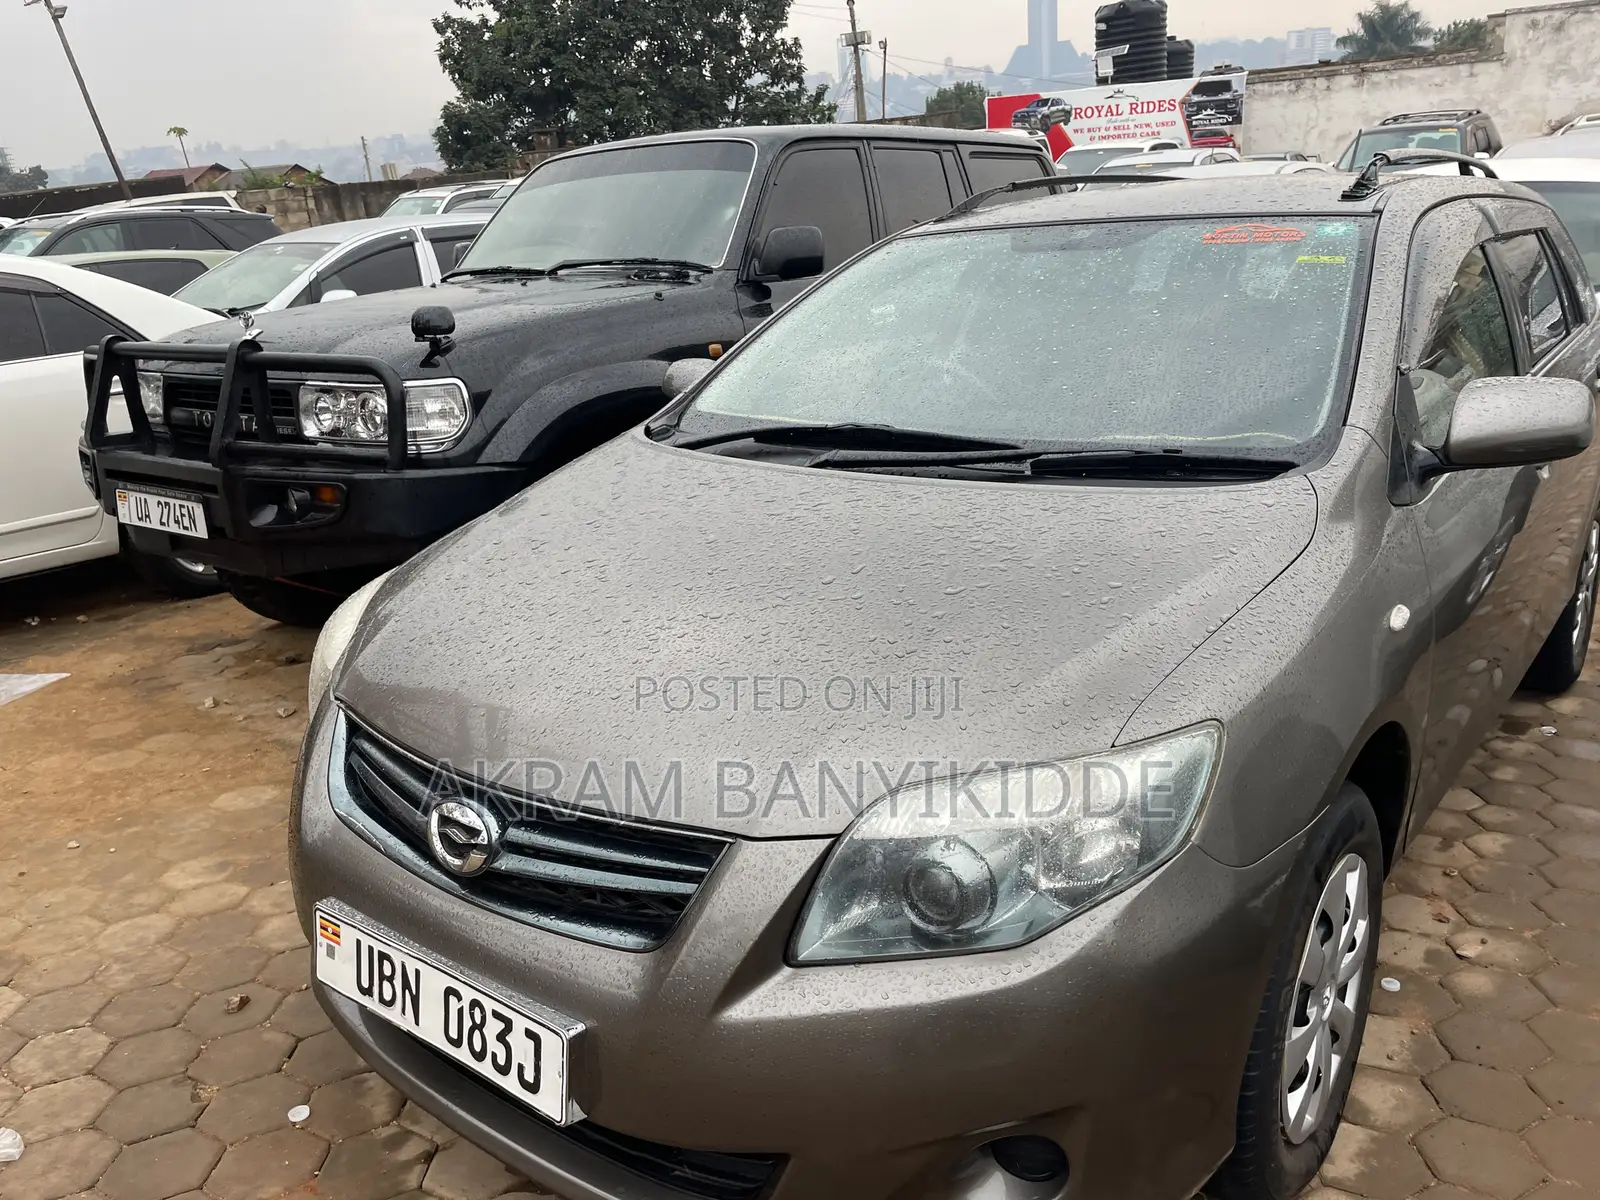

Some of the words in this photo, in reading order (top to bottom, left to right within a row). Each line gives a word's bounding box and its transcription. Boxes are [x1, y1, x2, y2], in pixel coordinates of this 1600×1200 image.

[1073, 104, 1124, 120] ROYAL
[1128, 99, 1177, 115] RIDES
[1098, 132, 1137, 141] IMPORTED
[1253, 231, 1307, 239] MOTORS
[193, 410, 258, 432] TOT
[134, 496, 152, 525] UA
[157, 500, 199, 533] 274EN
[355, 937, 422, 1027] UBN
[443, 985, 542, 1095] 083J
